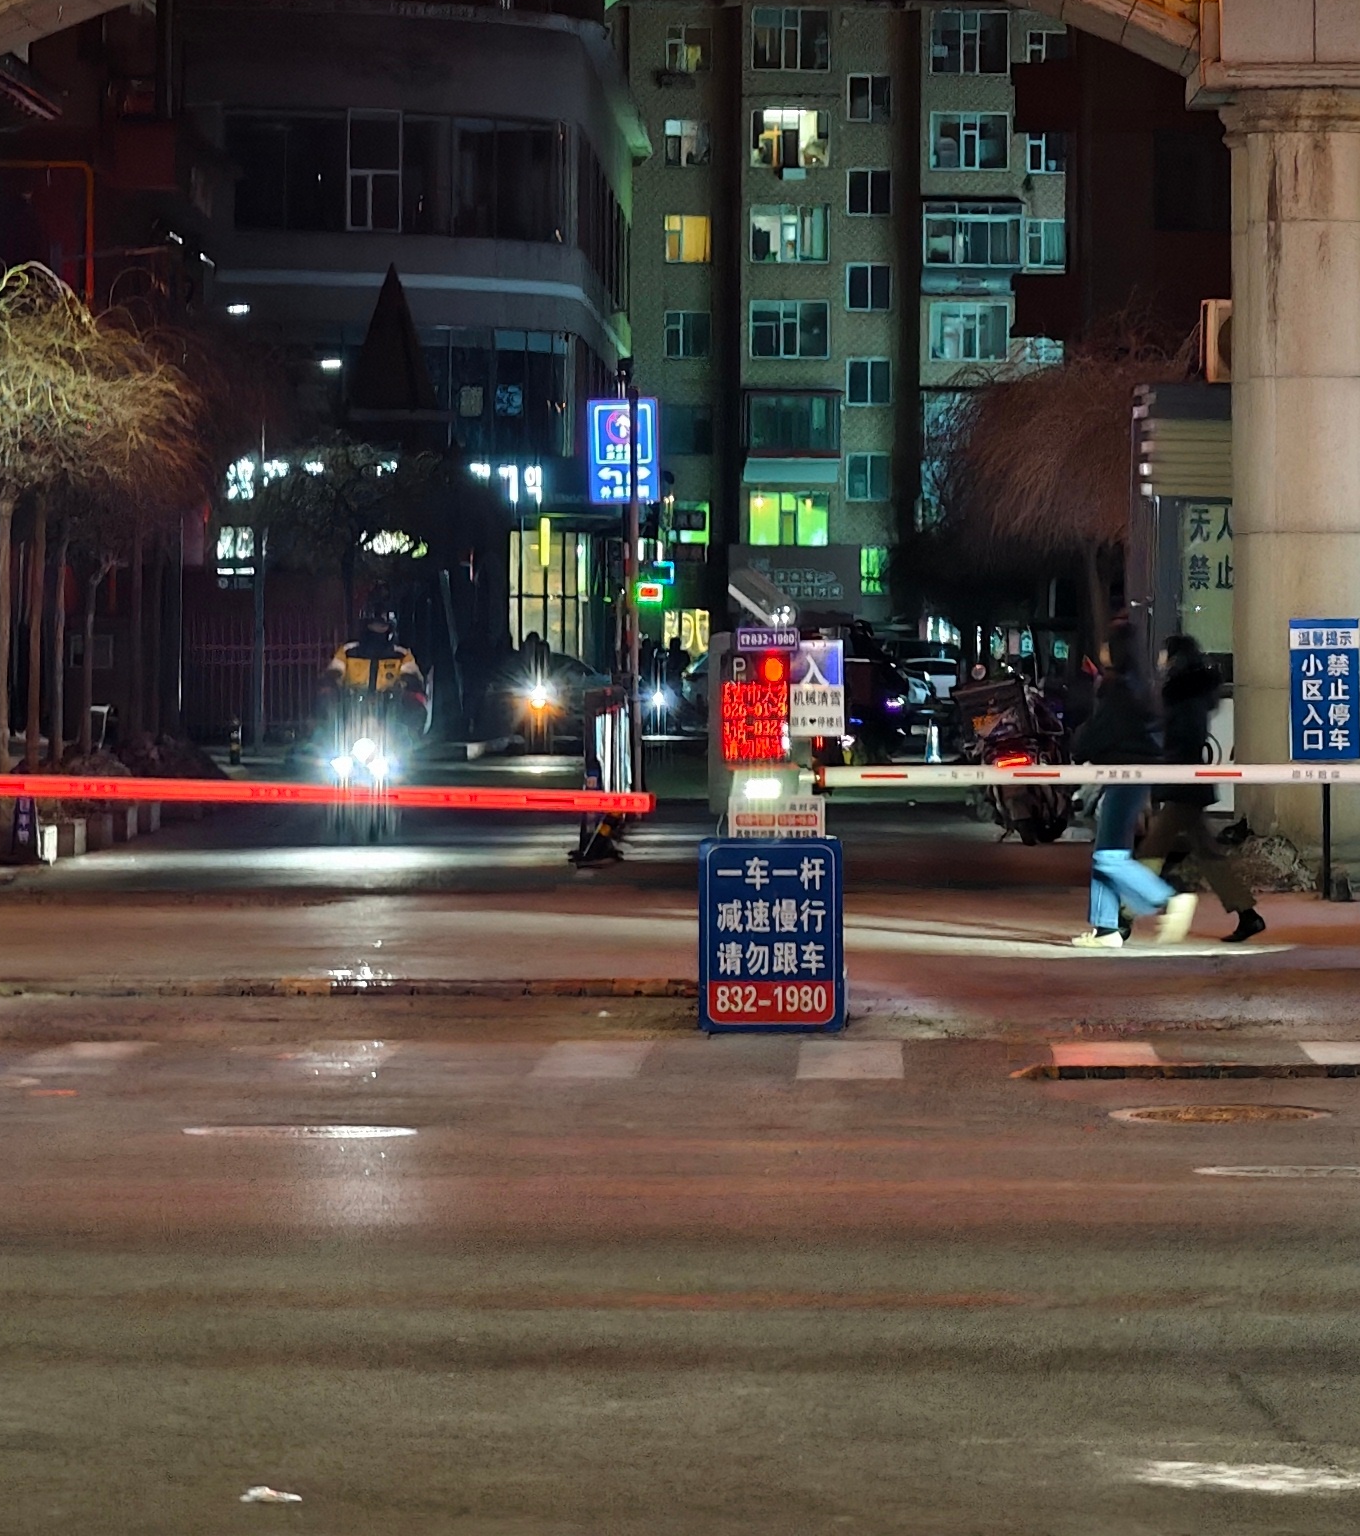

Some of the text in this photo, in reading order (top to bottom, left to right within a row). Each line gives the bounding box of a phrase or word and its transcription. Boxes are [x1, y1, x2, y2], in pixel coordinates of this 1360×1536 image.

[1298, 631, 1352, 646] 温馨提示
[1301, 653, 1324, 751] 小区入口
[1327, 653, 1351, 751] 禁止停车
[717, 856, 826, 891] 一车一杆
[717, 898, 827, 933] 减速慢行
[717, 941, 826, 976] 请勿跟车
[716, 984, 827, 1013] 832-1980
